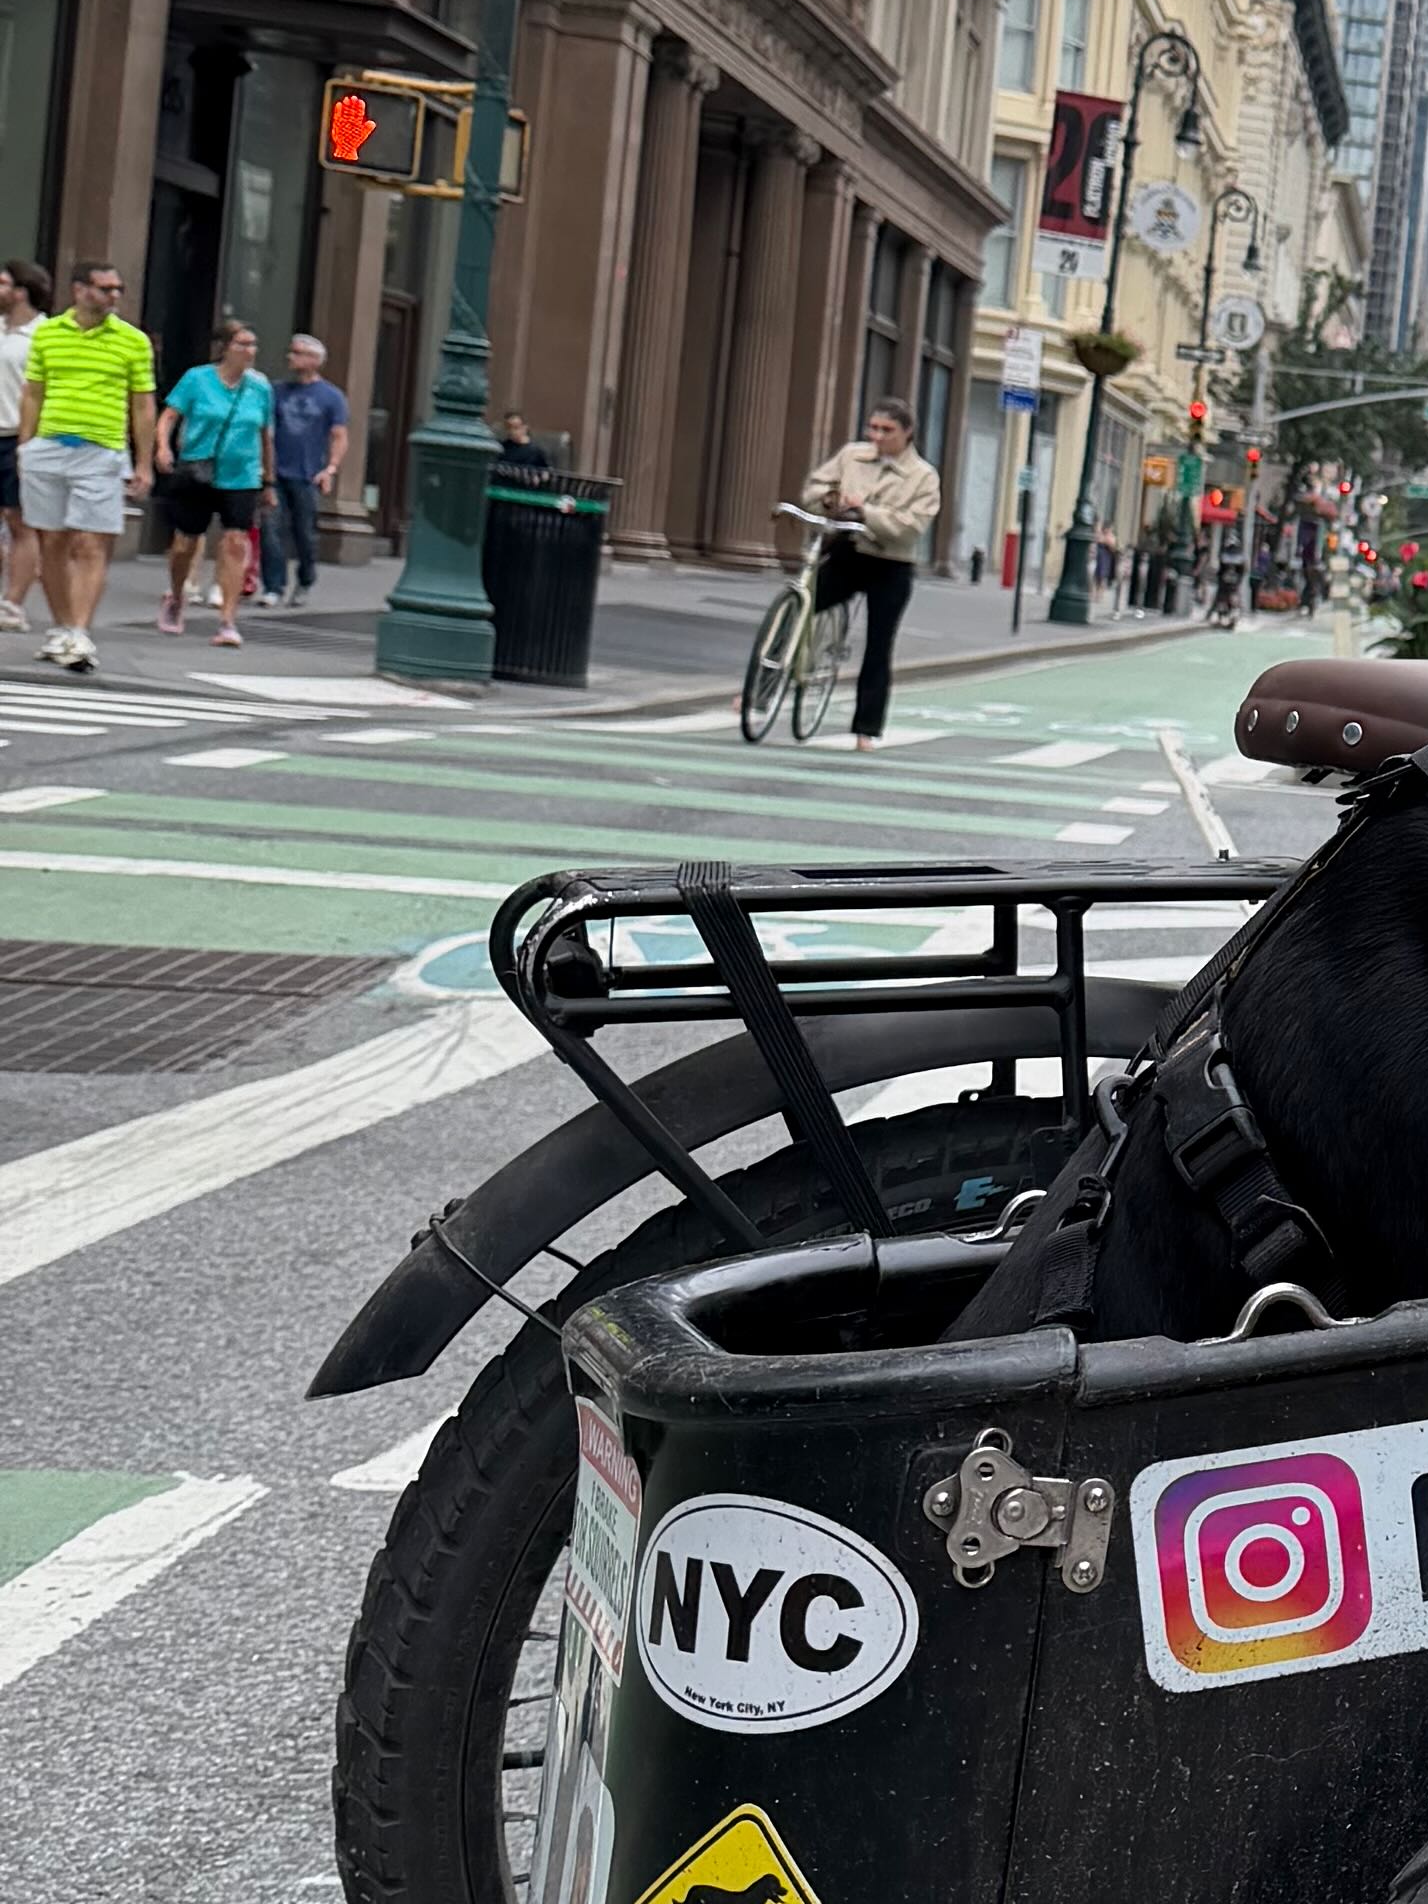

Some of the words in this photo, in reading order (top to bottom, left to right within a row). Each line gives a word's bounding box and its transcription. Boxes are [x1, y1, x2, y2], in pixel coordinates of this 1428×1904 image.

[586, 1418, 639, 1504] WARNING
[649, 1550, 865, 1673] NYC
[684, 1686, 706, 1705] New
[709, 1696, 733, 1713] York
[737, 1702, 764, 1717] City,
[767, 1700, 785, 1713] NY
